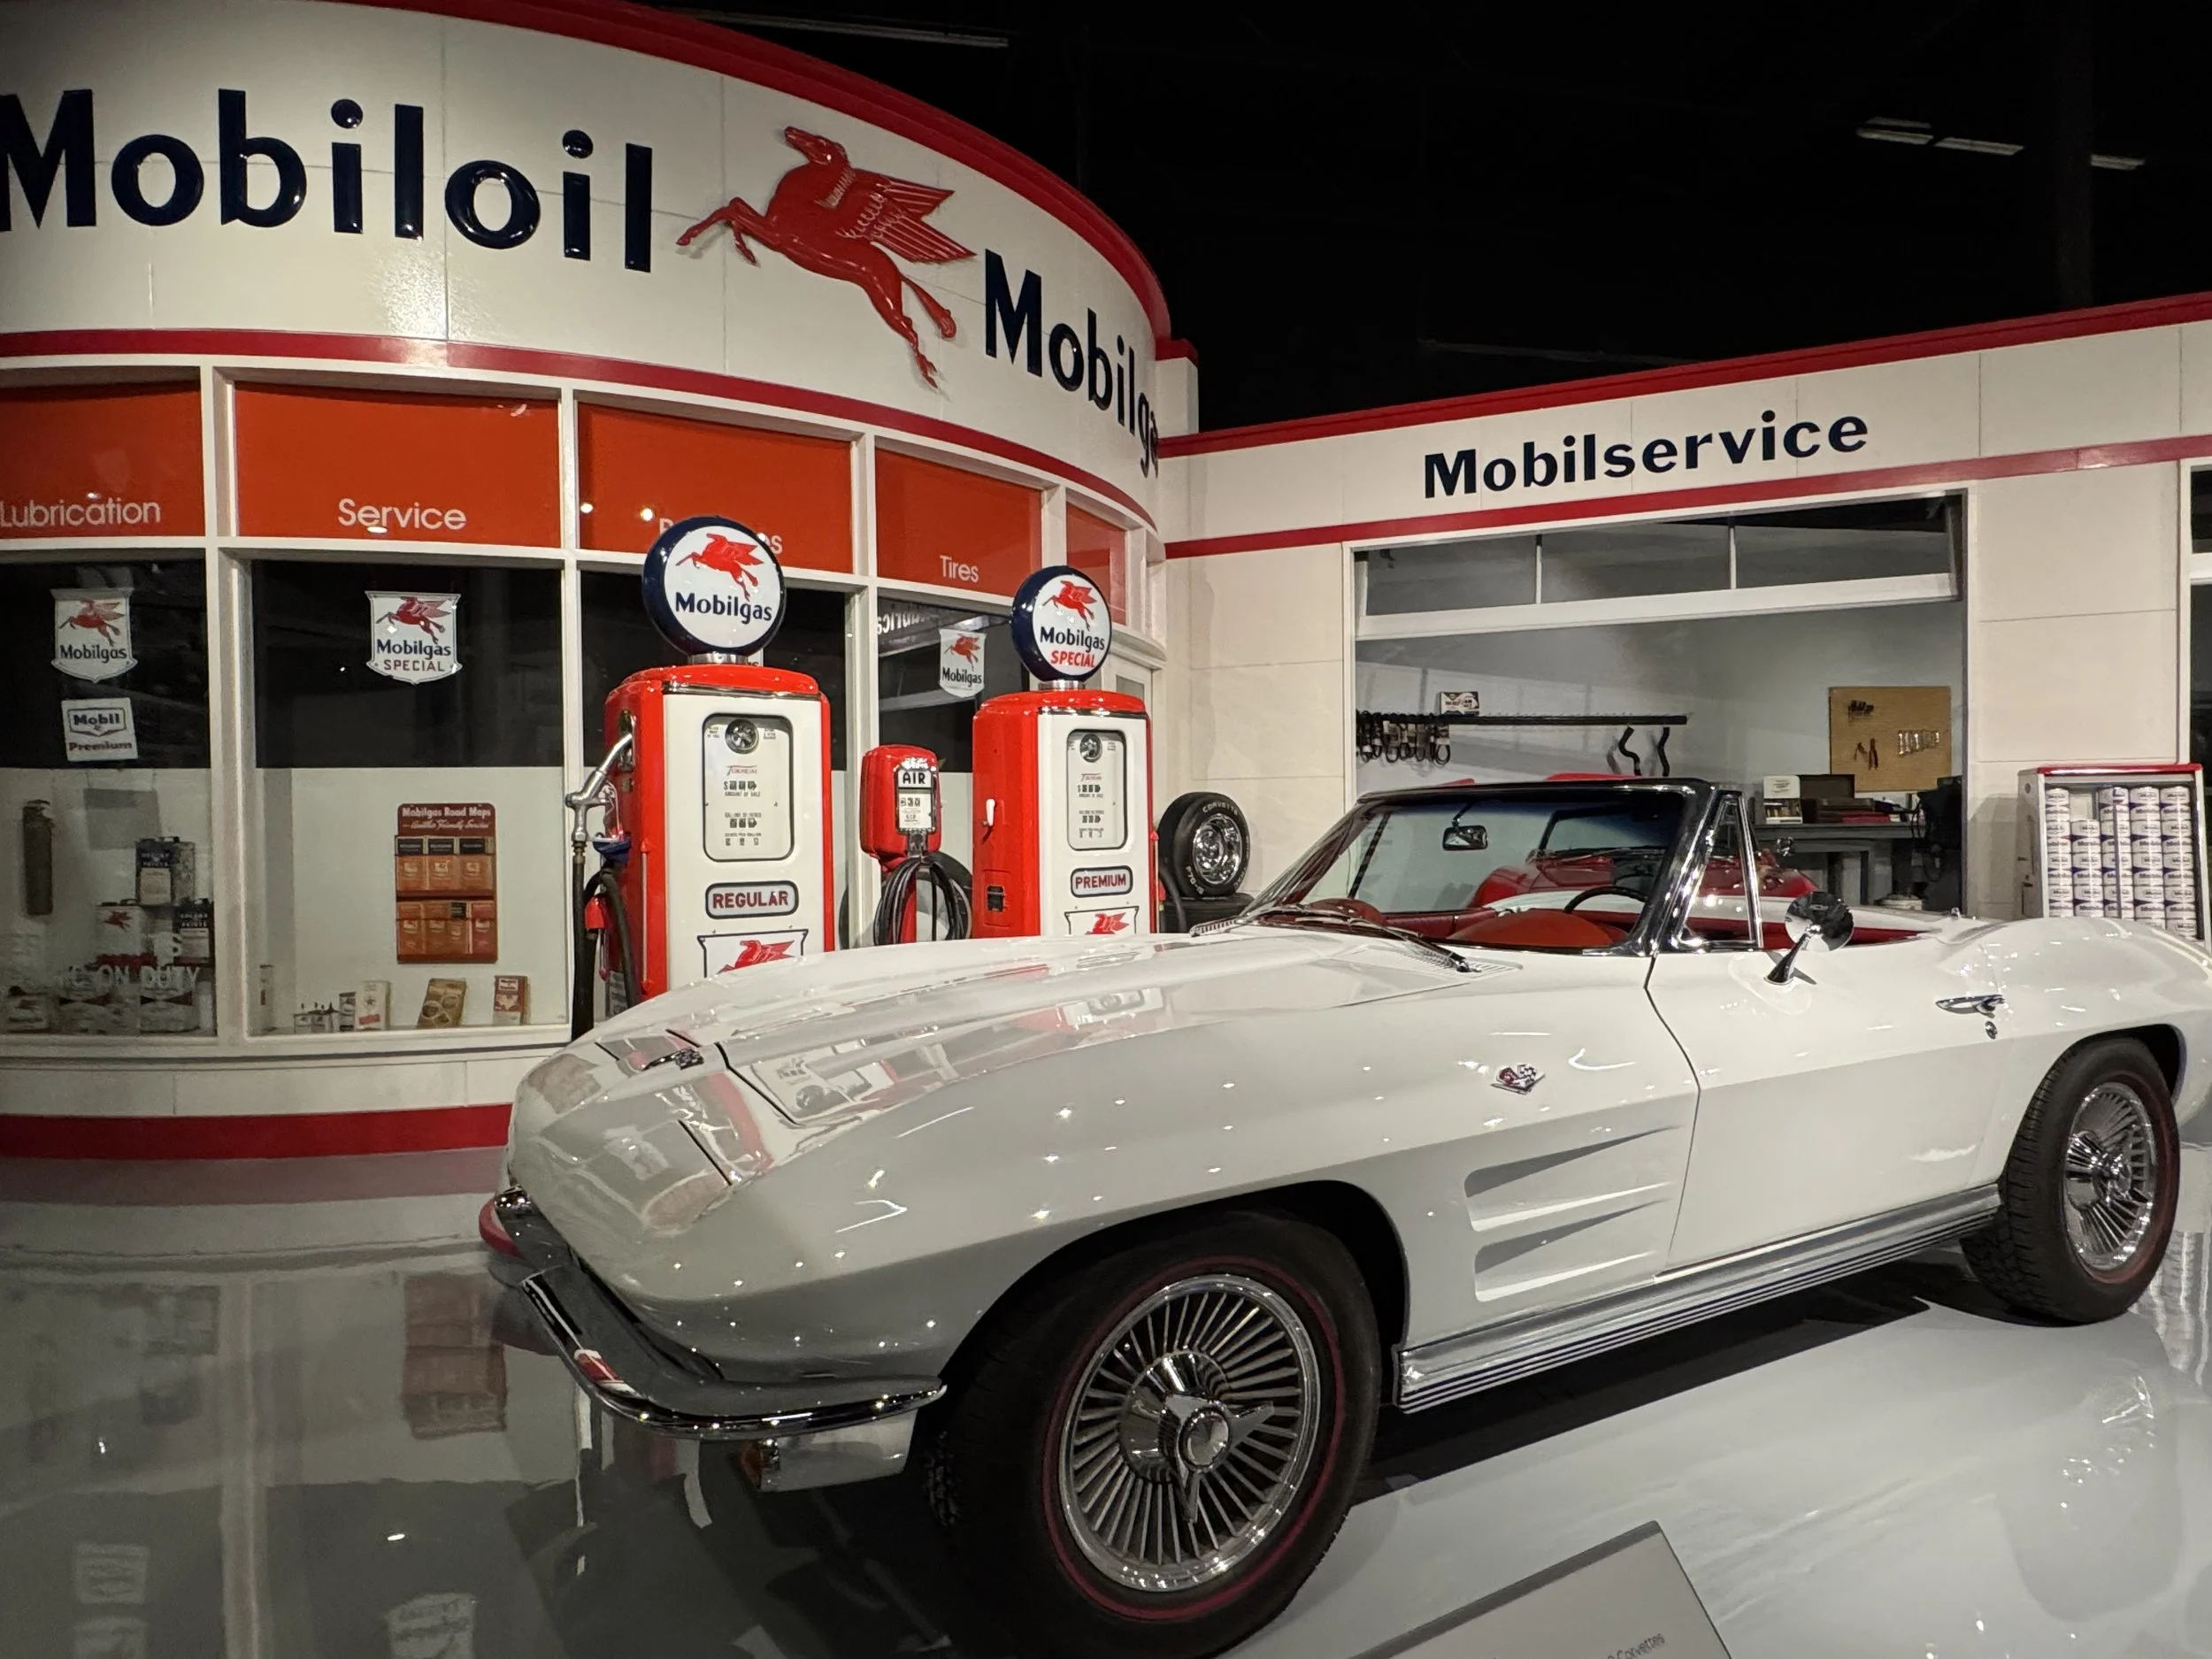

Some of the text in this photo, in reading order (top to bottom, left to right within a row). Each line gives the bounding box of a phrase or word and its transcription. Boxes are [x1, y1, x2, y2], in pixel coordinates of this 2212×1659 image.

[0, 87, 653, 273] Mobiloil
[984, 248, 1159, 480] Mobilga
[1424, 410, 1869, 499] Mobilservice
[0, 497, 161, 528] Lubrication
[338, 497, 467, 531] Service
[939, 554, 979, 583] Tires
[675, 591, 772, 625] Mobilgas
[376, 638, 452, 660] Mobilgas
[1040, 626, 1105, 653] Mobilgas
[59, 643, 128, 664] Mobilgas
[1050, 649, 1095, 668] SPECIAL
[383, 658, 446, 672] SPECIAL
[941, 666, 982, 687] Mobilgas
[73, 713, 120, 726] Mobil
[68, 741, 133, 752] Premium
[902, 771, 926, 785] AIR
[402, 806, 442, 819] Mobilgas
[444, 806, 467, 817] Road
[1075, 873, 1126, 890] PREMIUM
[712, 890, 789, 910] REGULAR
